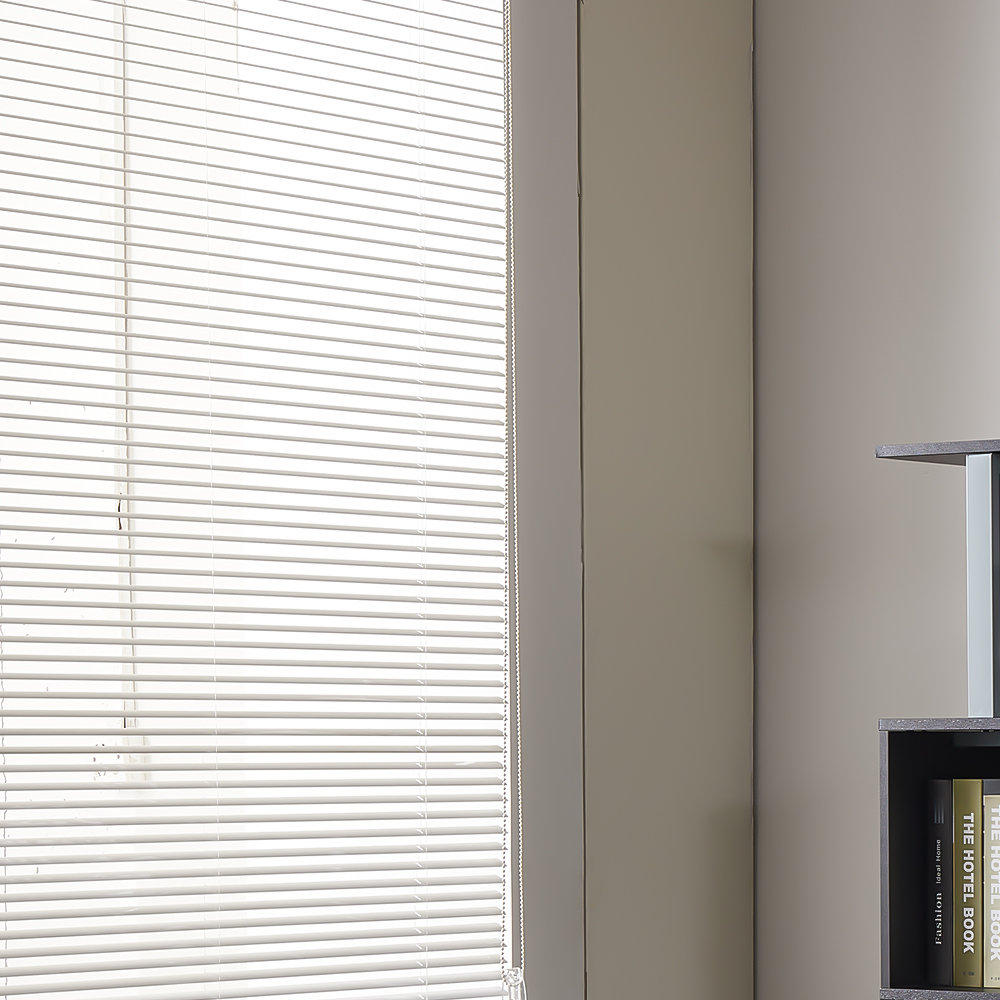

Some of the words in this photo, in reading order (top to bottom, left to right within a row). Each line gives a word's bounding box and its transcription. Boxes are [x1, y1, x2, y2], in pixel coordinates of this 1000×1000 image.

[963, 812, 975, 845] THE
[963, 850, 975, 903] HOTEL
[934, 892, 942, 945] Fashion
[963, 907, 975, 954] BOOK
